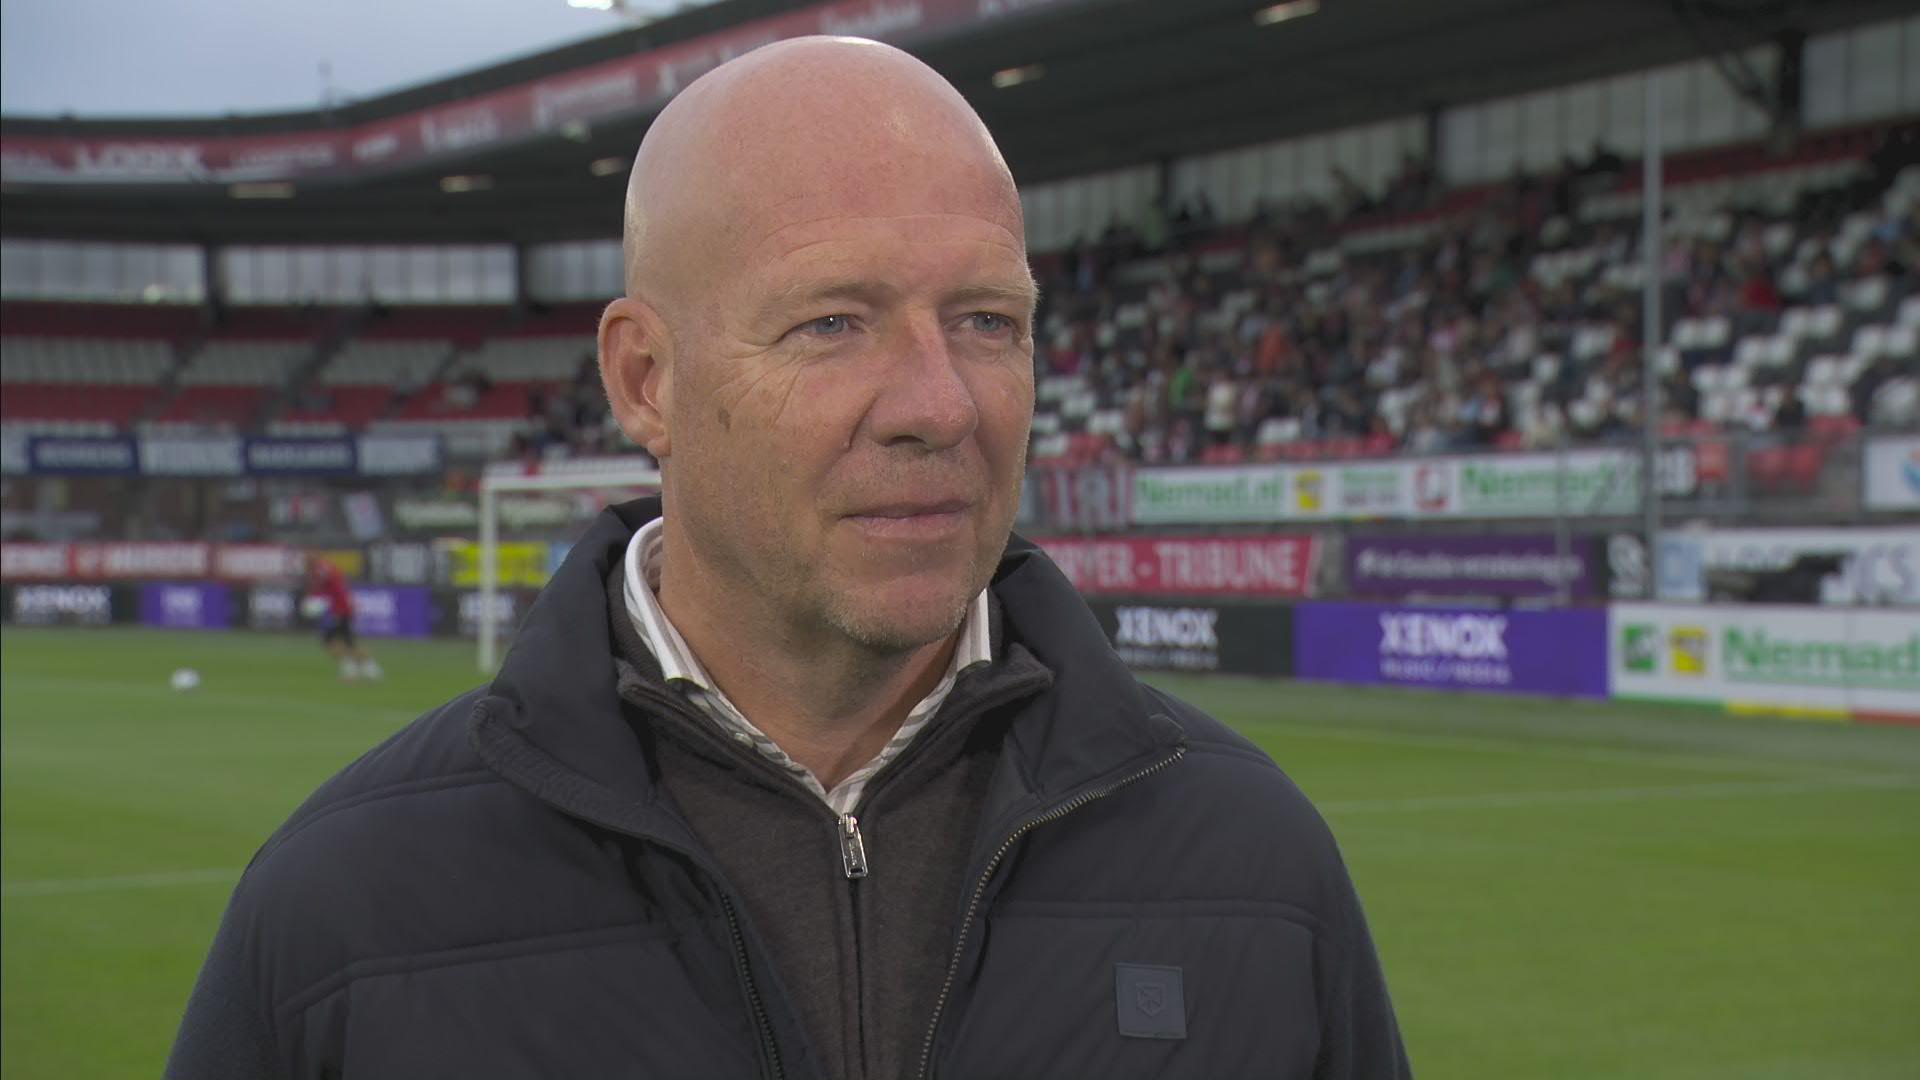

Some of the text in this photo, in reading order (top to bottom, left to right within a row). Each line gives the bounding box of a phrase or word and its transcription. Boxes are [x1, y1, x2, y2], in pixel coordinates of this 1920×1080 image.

[1153, 541, 1298, 589] TRIBUNE
[1116, 607, 1218, 648] XENOX
[1379, 612, 1507, 658] XENOX
